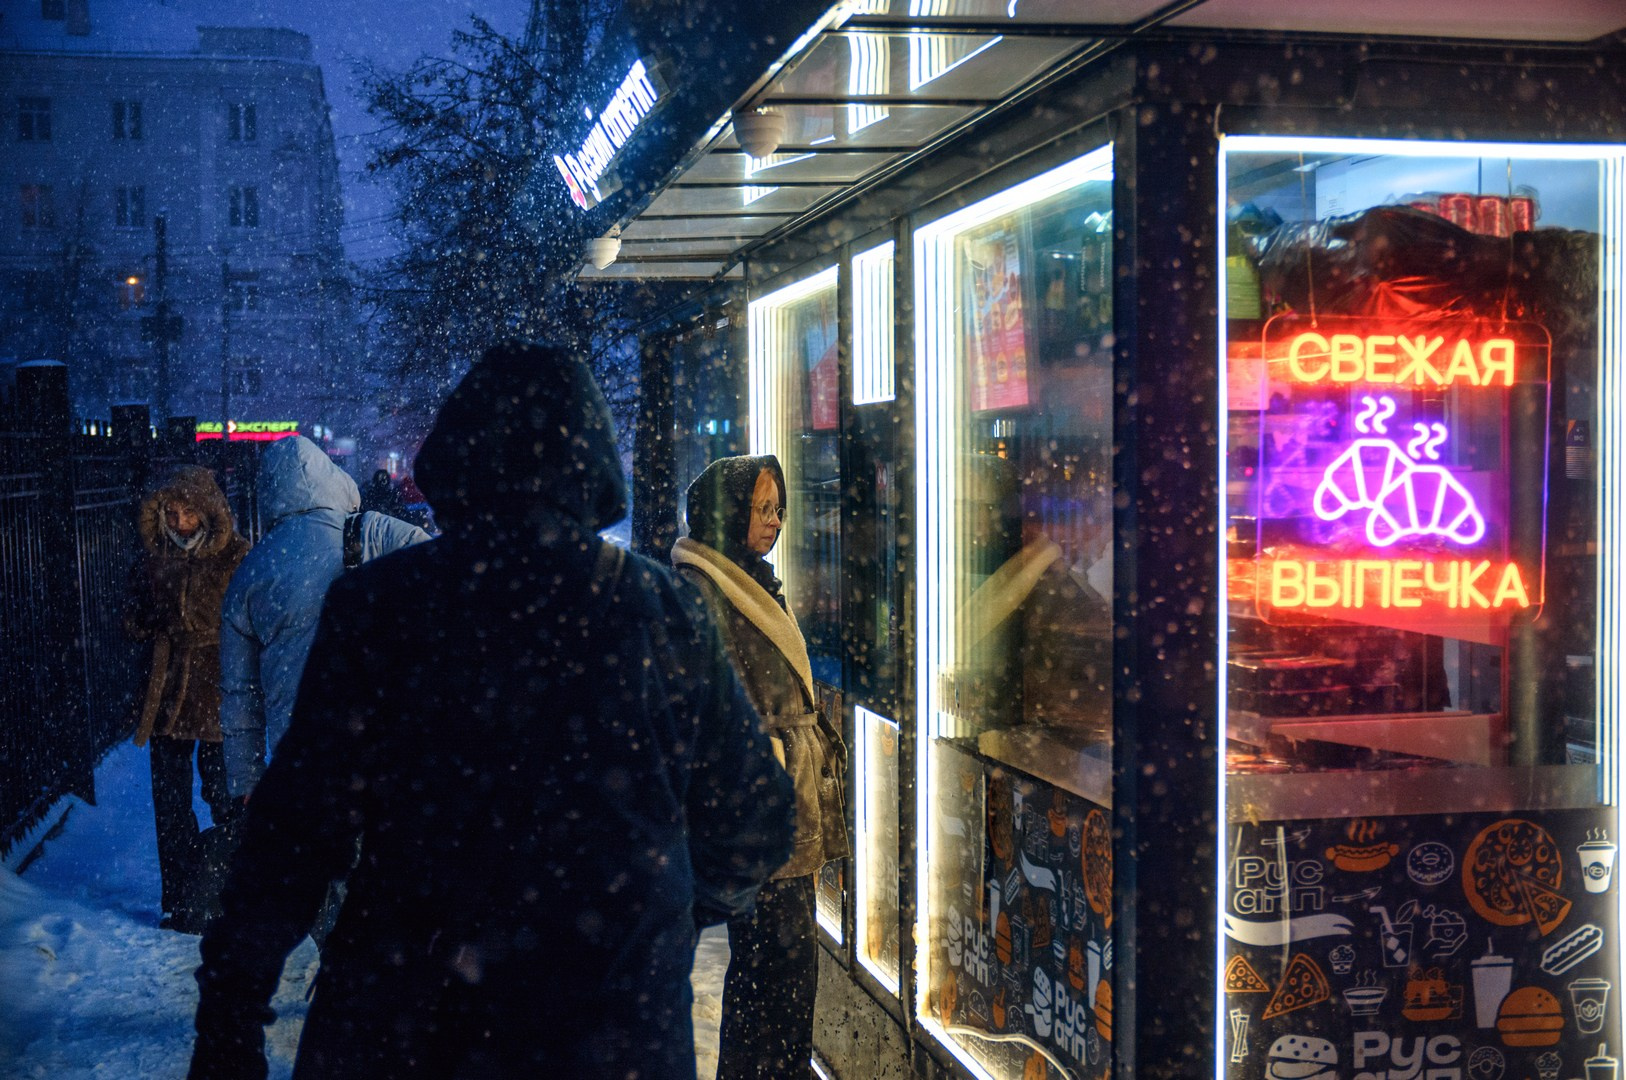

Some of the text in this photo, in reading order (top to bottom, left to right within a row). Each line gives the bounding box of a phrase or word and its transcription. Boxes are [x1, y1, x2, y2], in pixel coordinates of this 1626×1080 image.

[1288, 332, 1516, 387] СВЕЖАЯ
[237, 421, 299, 432] ЭКСПЕРТ
[1271, 559, 1530, 609] ВЫПЕЧКА
[1235, 856, 1324, 898] Рус
[964, 916, 989, 964] Рус
[1055, 981, 1086, 1037] Рус
[1353, 1031, 1462, 1080] Рус
